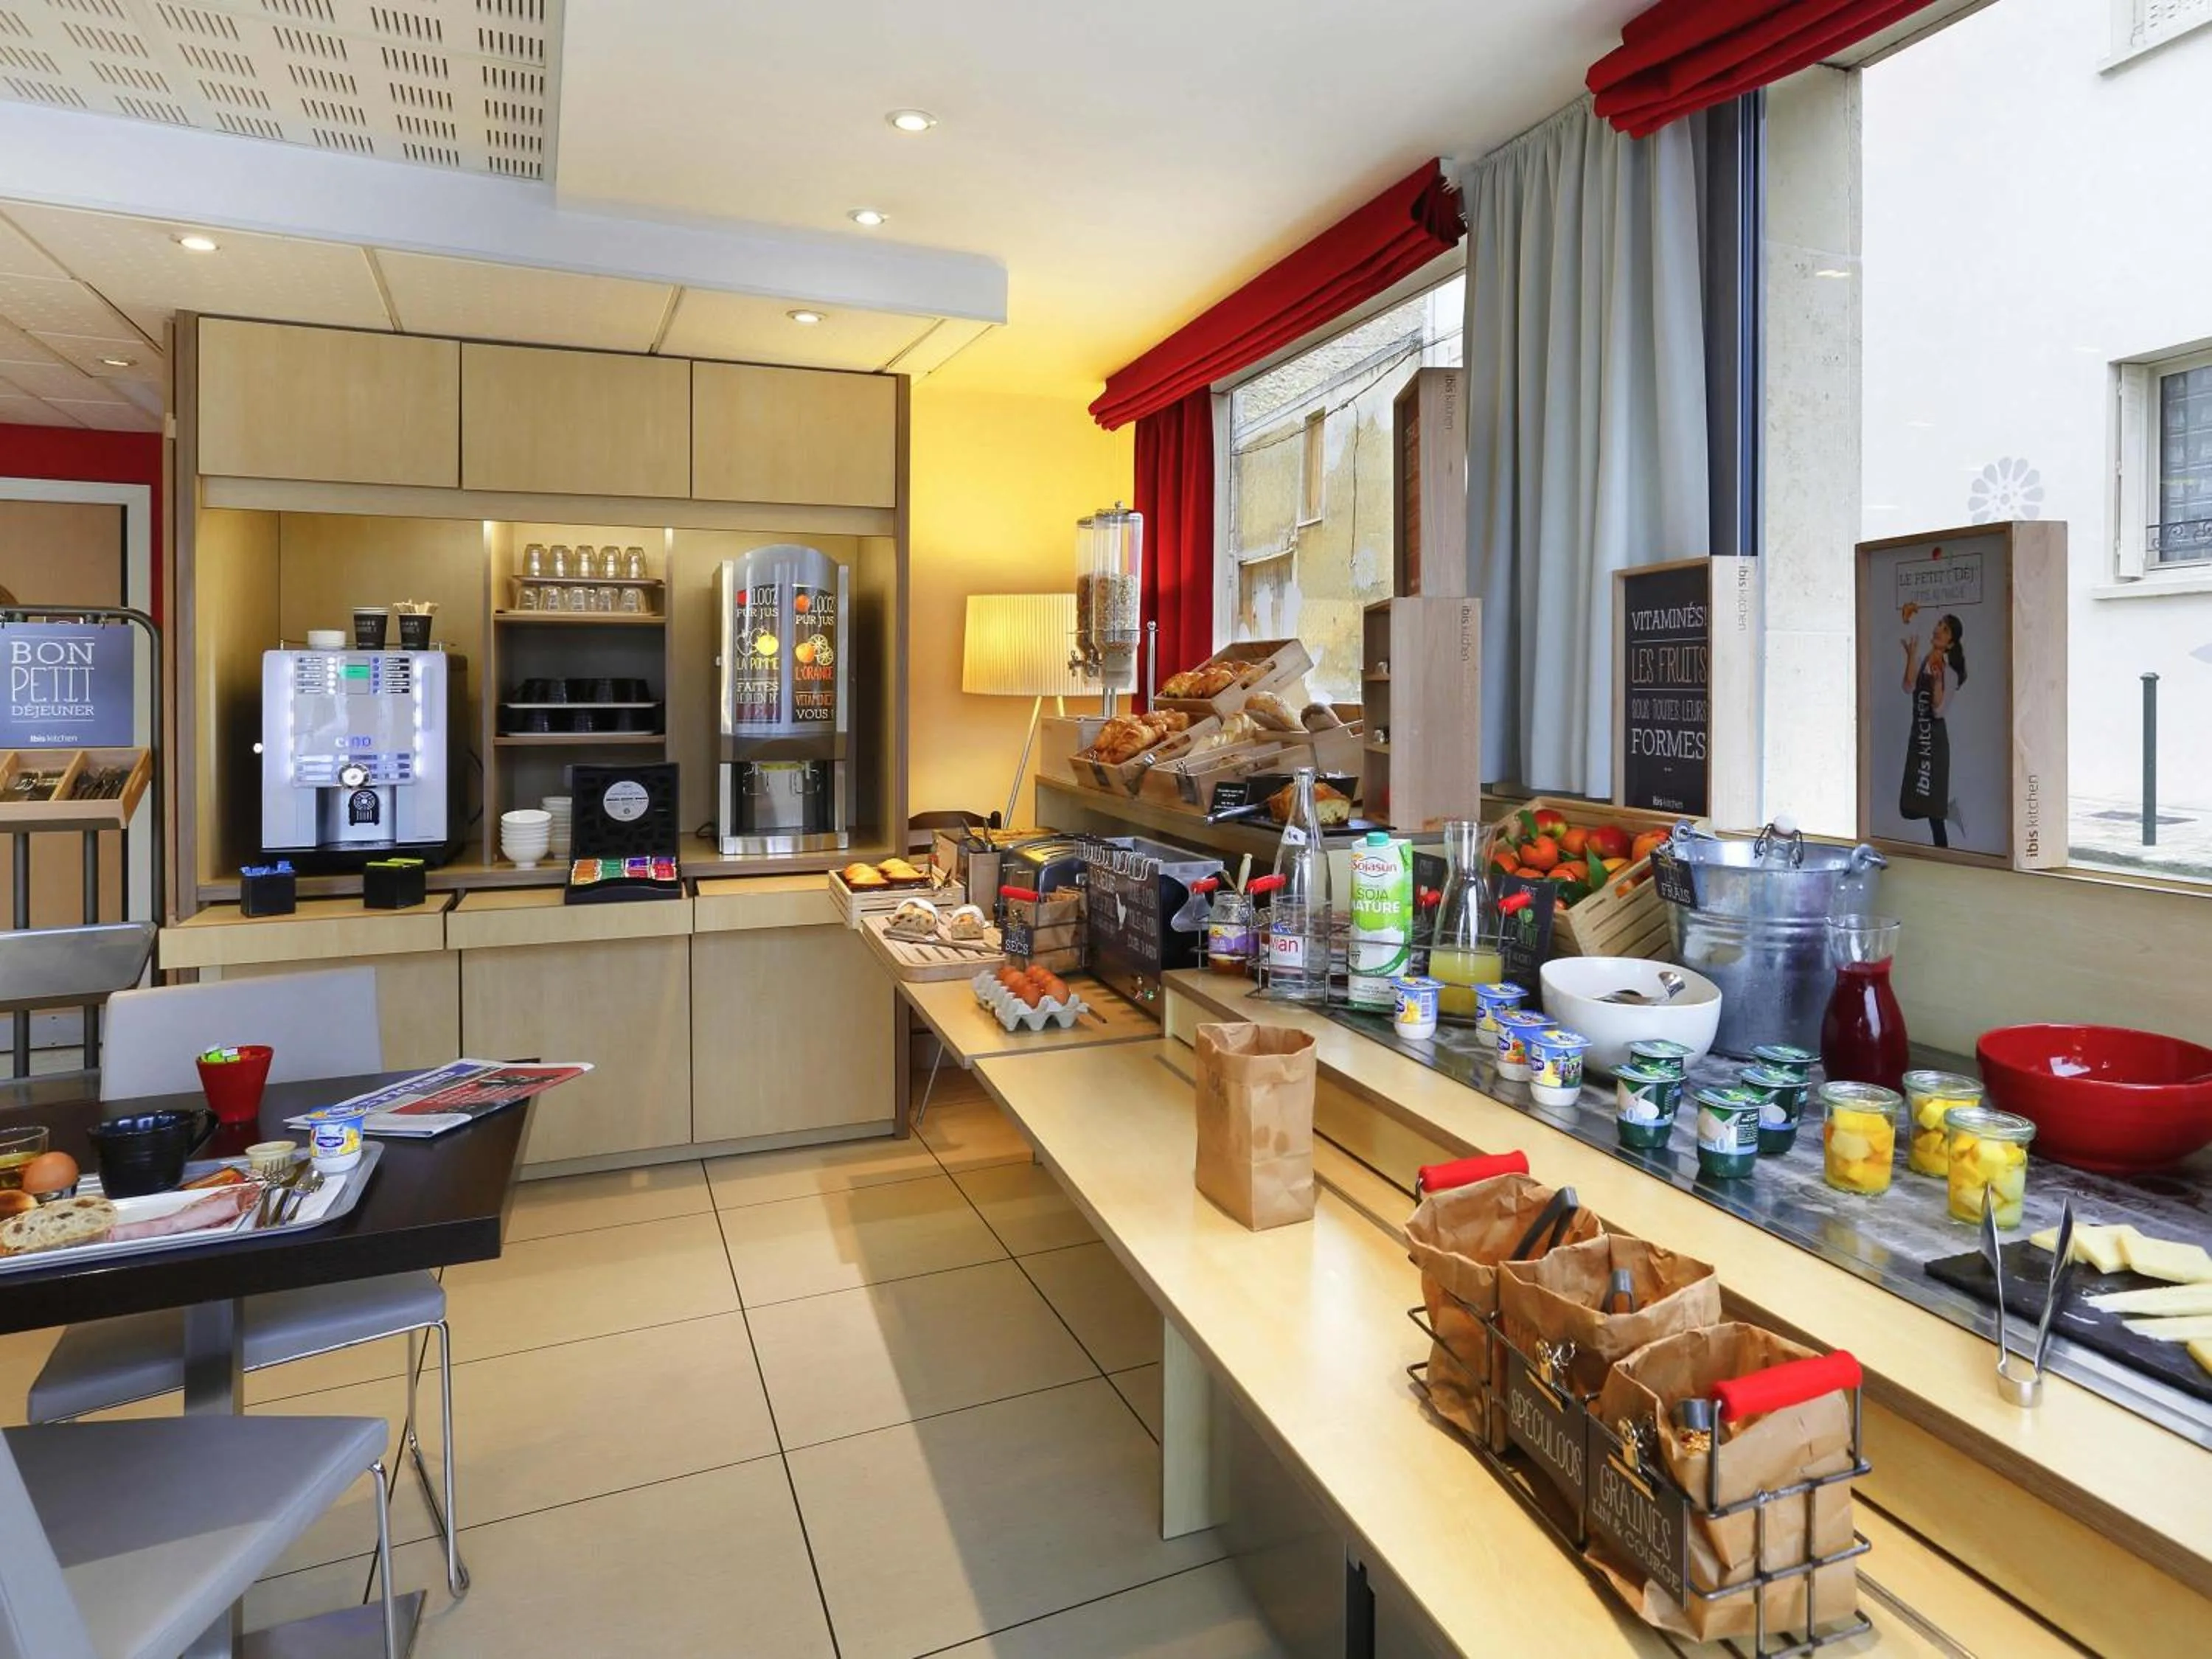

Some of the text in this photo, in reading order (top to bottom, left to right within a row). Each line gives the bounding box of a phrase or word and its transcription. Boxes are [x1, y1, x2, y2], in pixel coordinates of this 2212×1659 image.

[1739, 566, 1749, 587] ibis
[759, 607, 779, 619] JUS
[796, 615, 835, 627] PUR JUS
[11, 641, 95, 664] BON
[1632, 646, 1707, 684] LES FRUITS
[11, 666, 95, 702] PETIT
[12, 703, 95, 718] DÉJEUNER
[796, 709, 829, 720] VOUS
[1631, 728, 1706, 759] FORMES
[1916, 690, 1930, 796] ibis kitchen
[2025, 775, 2039, 857] ibis kitchen
[1357, 887, 1388, 900] SOJA
[1600, 1464, 1671, 1560] GRAINES
